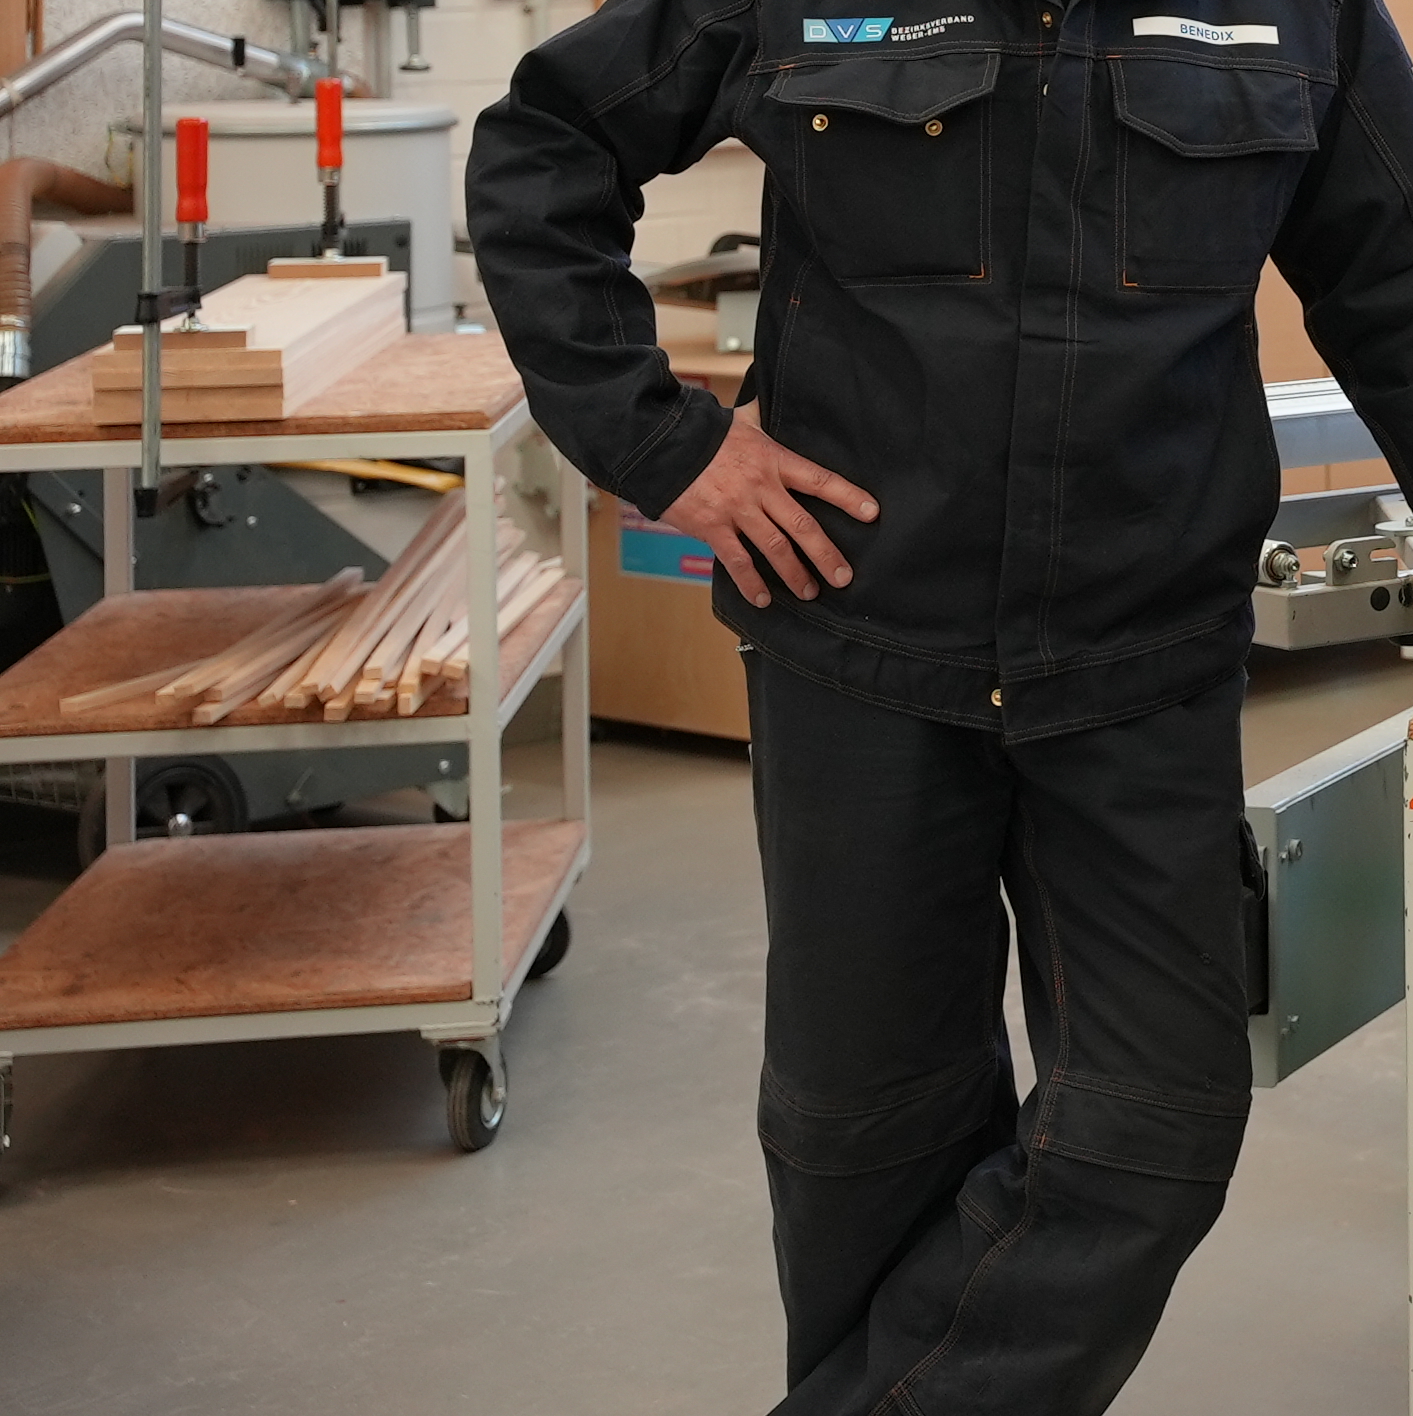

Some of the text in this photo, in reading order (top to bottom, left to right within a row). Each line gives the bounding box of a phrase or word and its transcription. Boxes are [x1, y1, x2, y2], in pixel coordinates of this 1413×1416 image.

[806, 23, 885, 40] DVS
[890, 14, 975, 35] BEZIRKSVERBAND
[890, 25, 946, 42] WESER-EMS
[1179, 22, 1235, 42] BENEDIX
